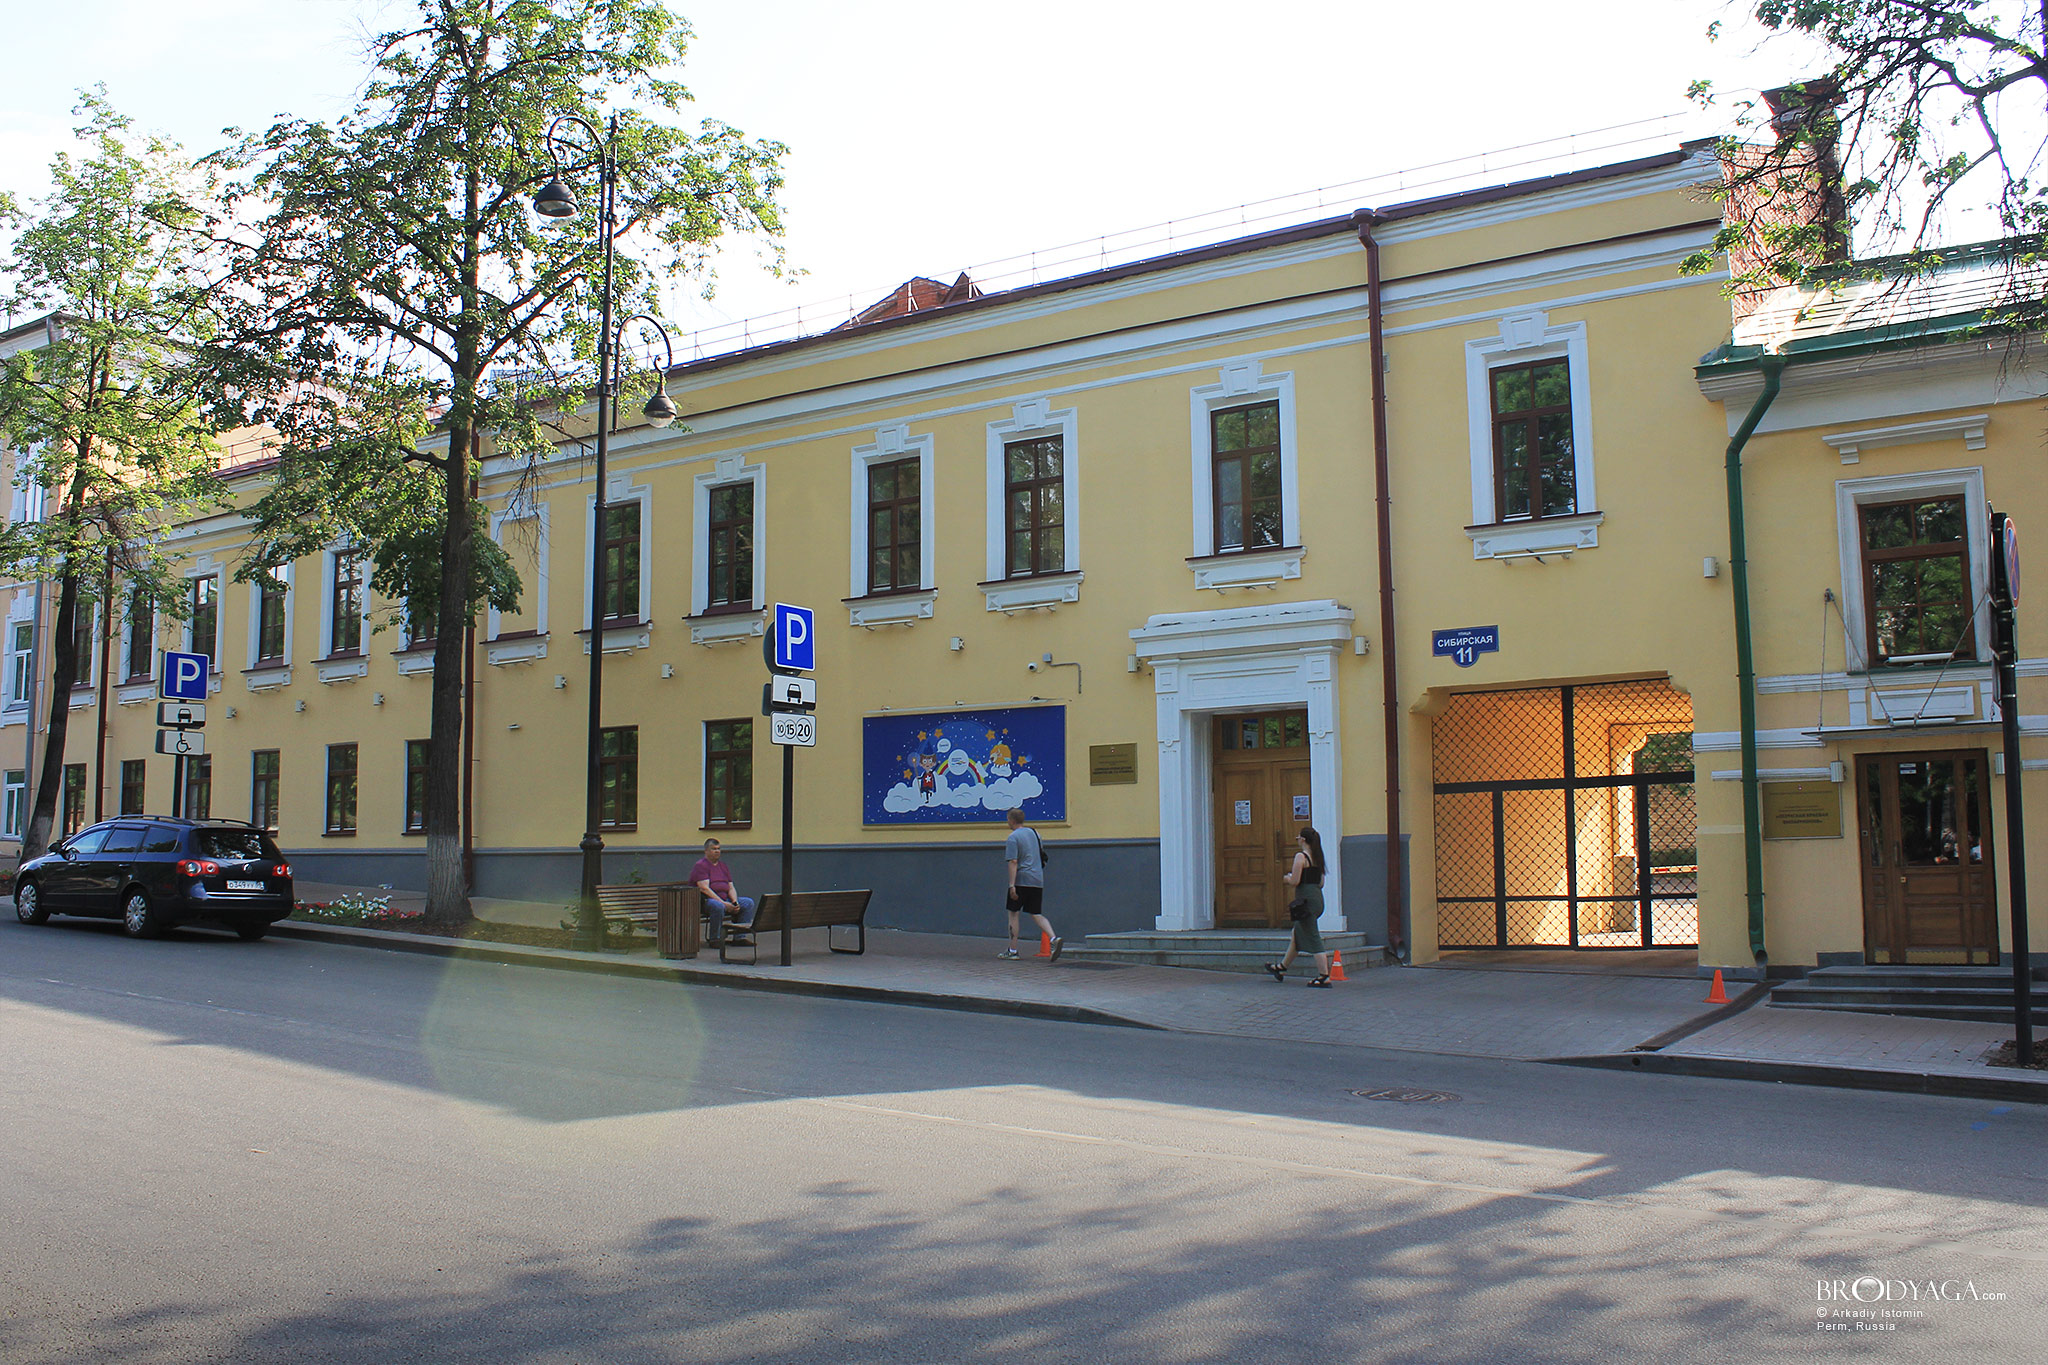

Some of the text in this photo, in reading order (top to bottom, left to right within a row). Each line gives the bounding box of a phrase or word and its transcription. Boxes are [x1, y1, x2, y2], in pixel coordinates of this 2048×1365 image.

[786, 612, 807, 660] P
[1437, 635, 1493, 647] СИБИРСКАЯ
[1456, 647, 1472, 663] 11
[176, 657, 201, 693] P
[776, 723, 811, 737] 10 15 20
